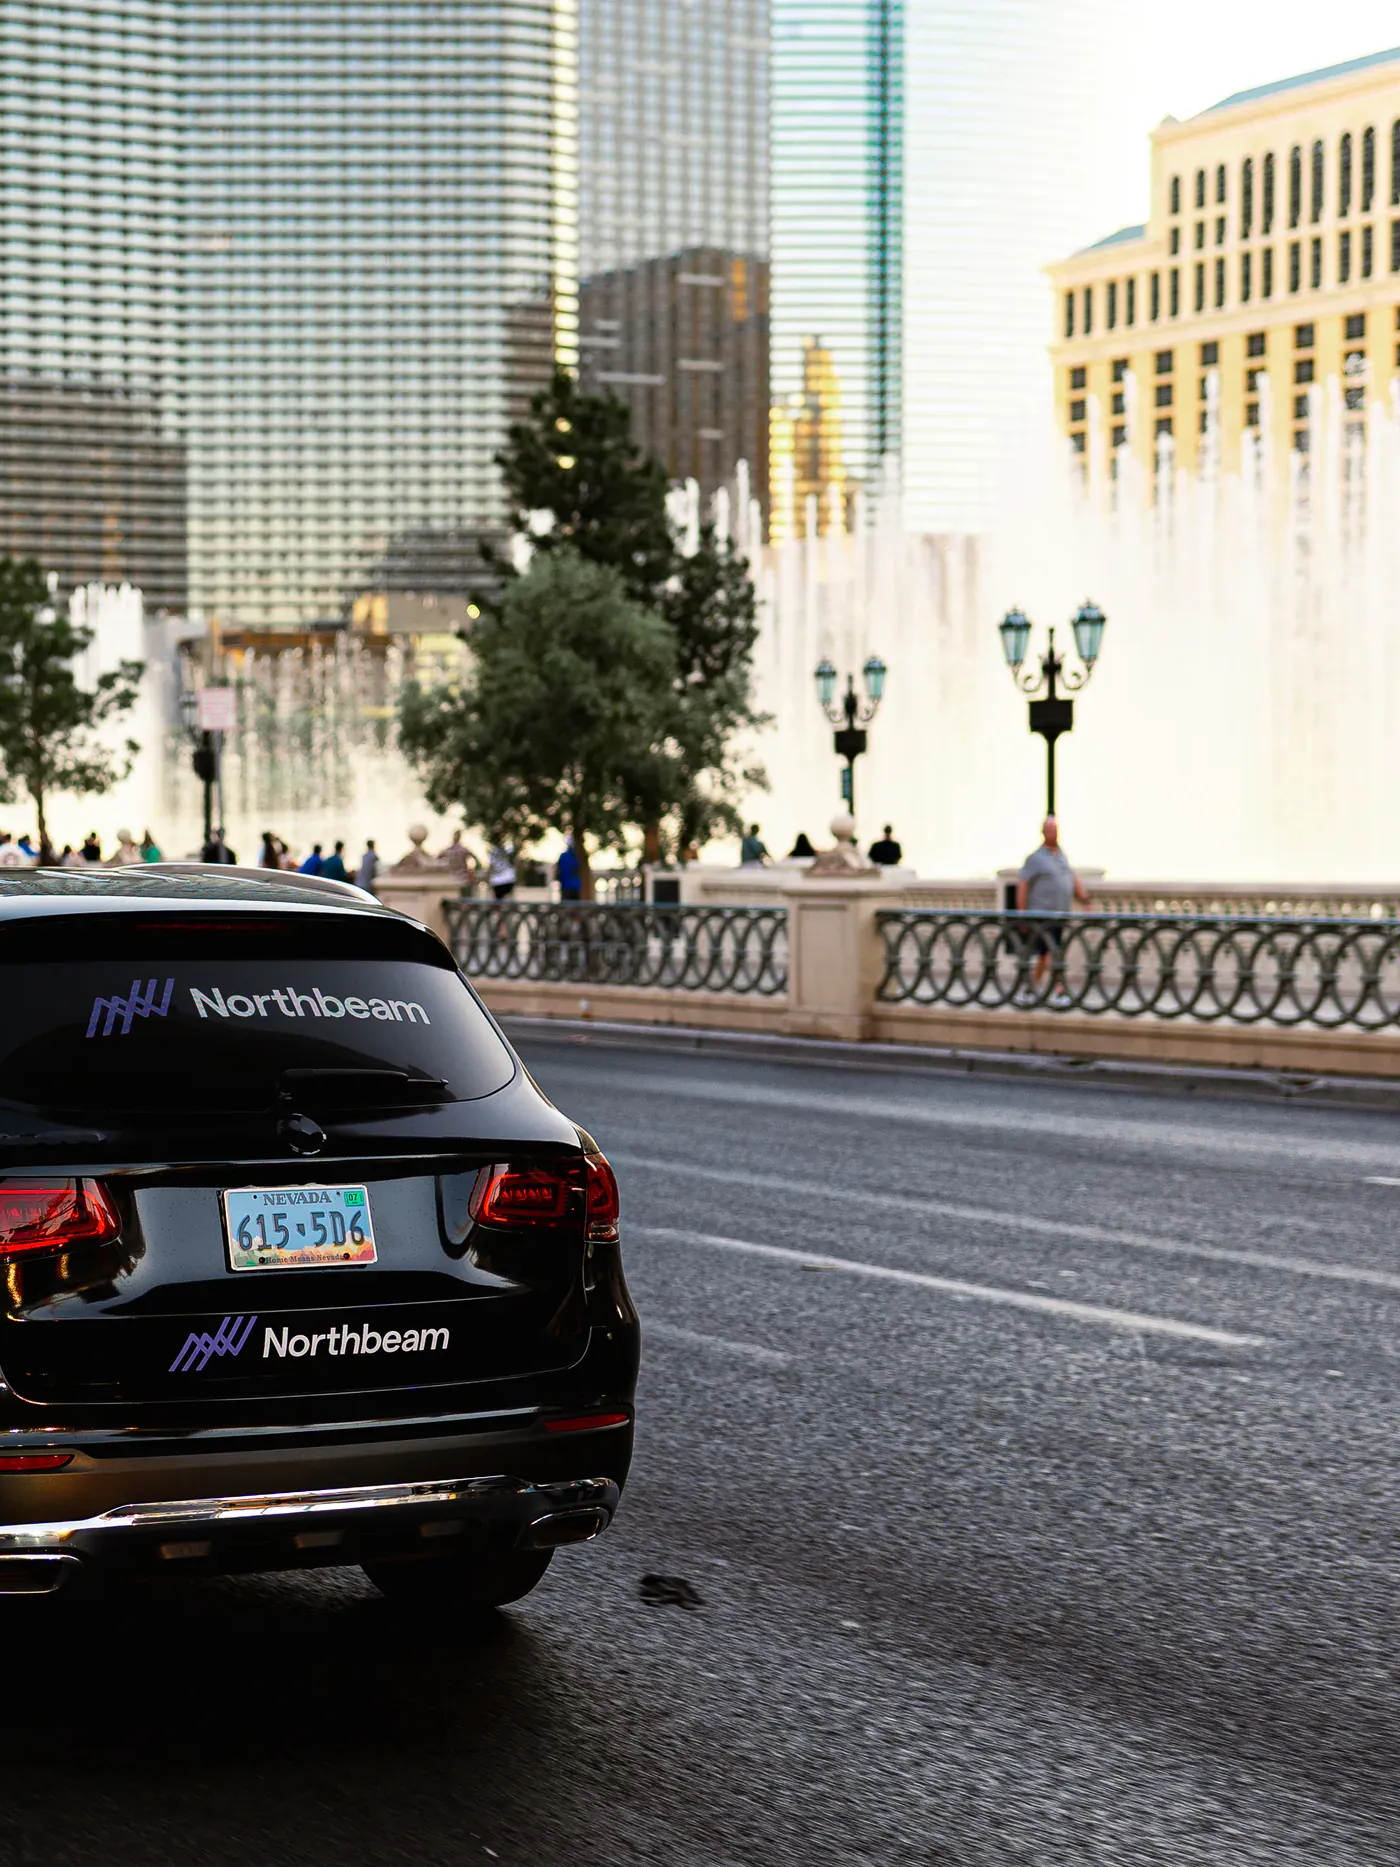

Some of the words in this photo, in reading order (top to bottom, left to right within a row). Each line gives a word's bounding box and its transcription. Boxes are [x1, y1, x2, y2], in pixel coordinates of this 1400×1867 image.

[190, 986, 431, 1026] Northbeam
[263, 1191, 332, 1206] NEVADA
[348, 1193, 358, 1202] 07
[265, 1256, 289, 1264] Home
[290, 1255, 314, 1263] Means
[262, 1323, 450, 1359] Northbeam
